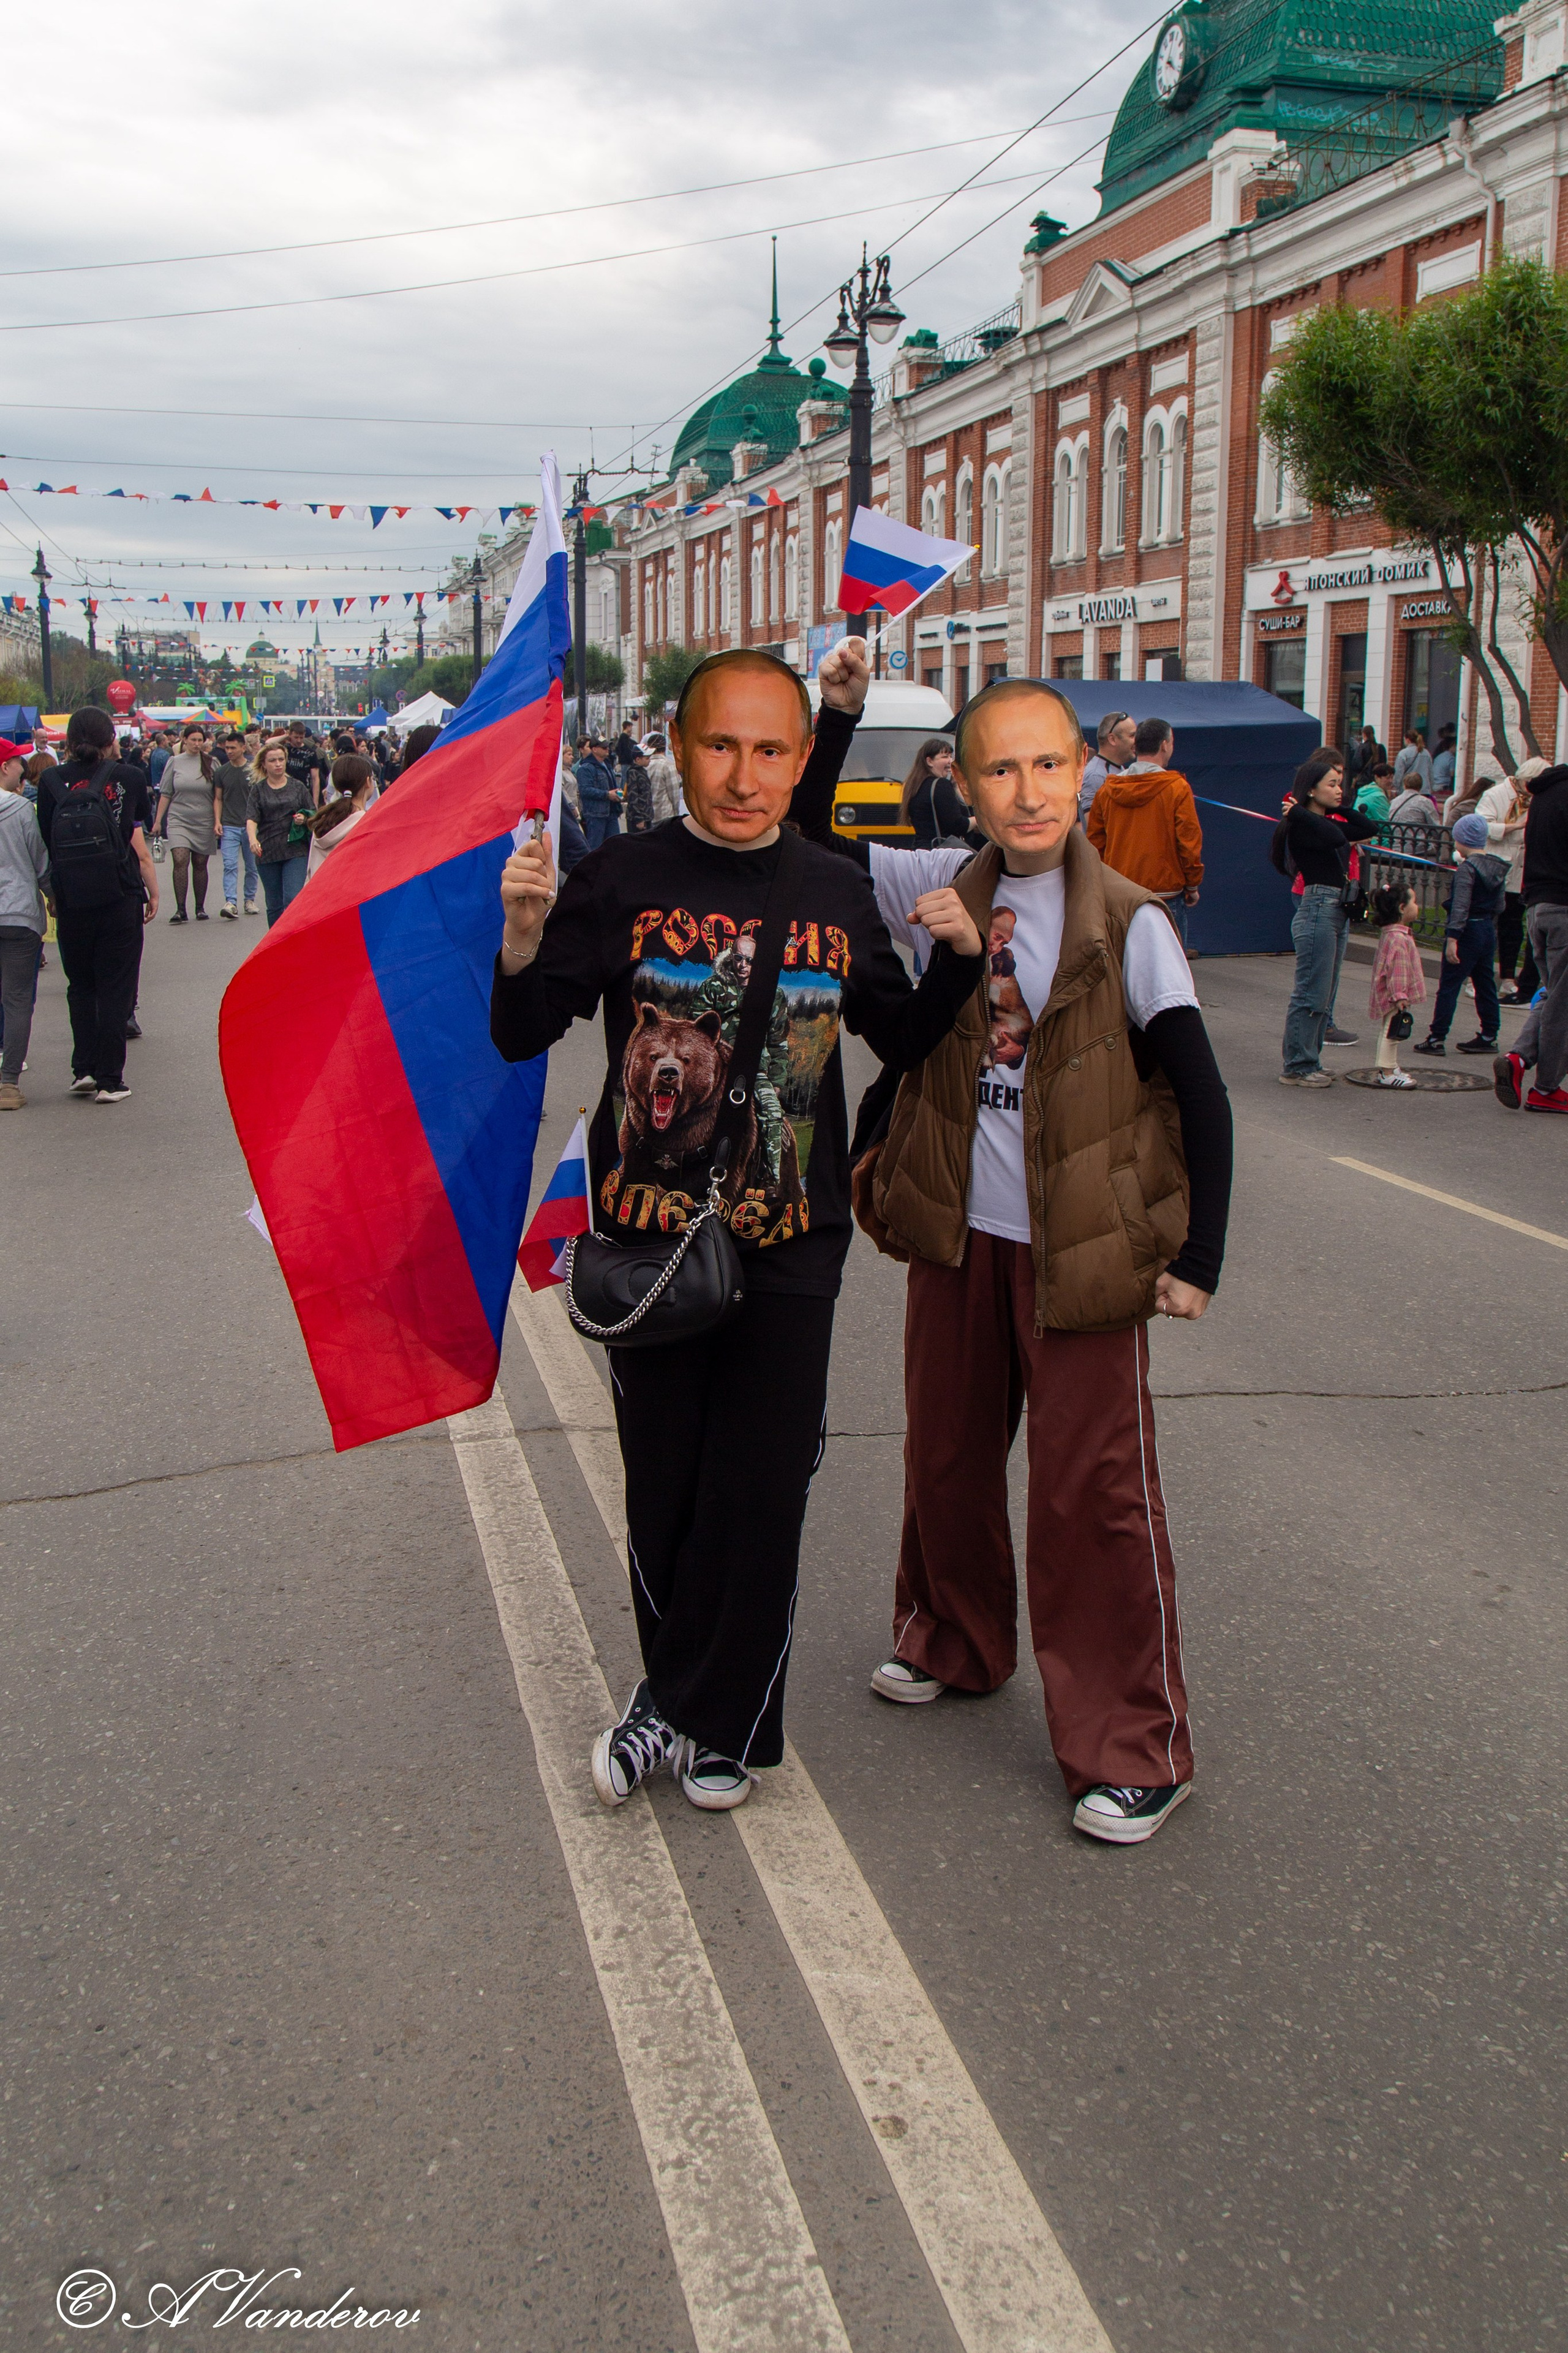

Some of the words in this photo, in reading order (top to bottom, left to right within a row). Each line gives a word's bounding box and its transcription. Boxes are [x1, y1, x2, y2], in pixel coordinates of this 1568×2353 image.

[1305, 564, 1371, 591] ЯПОНСКИЙ
[1378, 561, 1427, 582] ДОМИК
[1079, 596, 1137, 624] LAVANDA
[1259, 616, 1300, 630] СУШИ-БАР
[980, 1081, 1023, 1111] ДЕН
